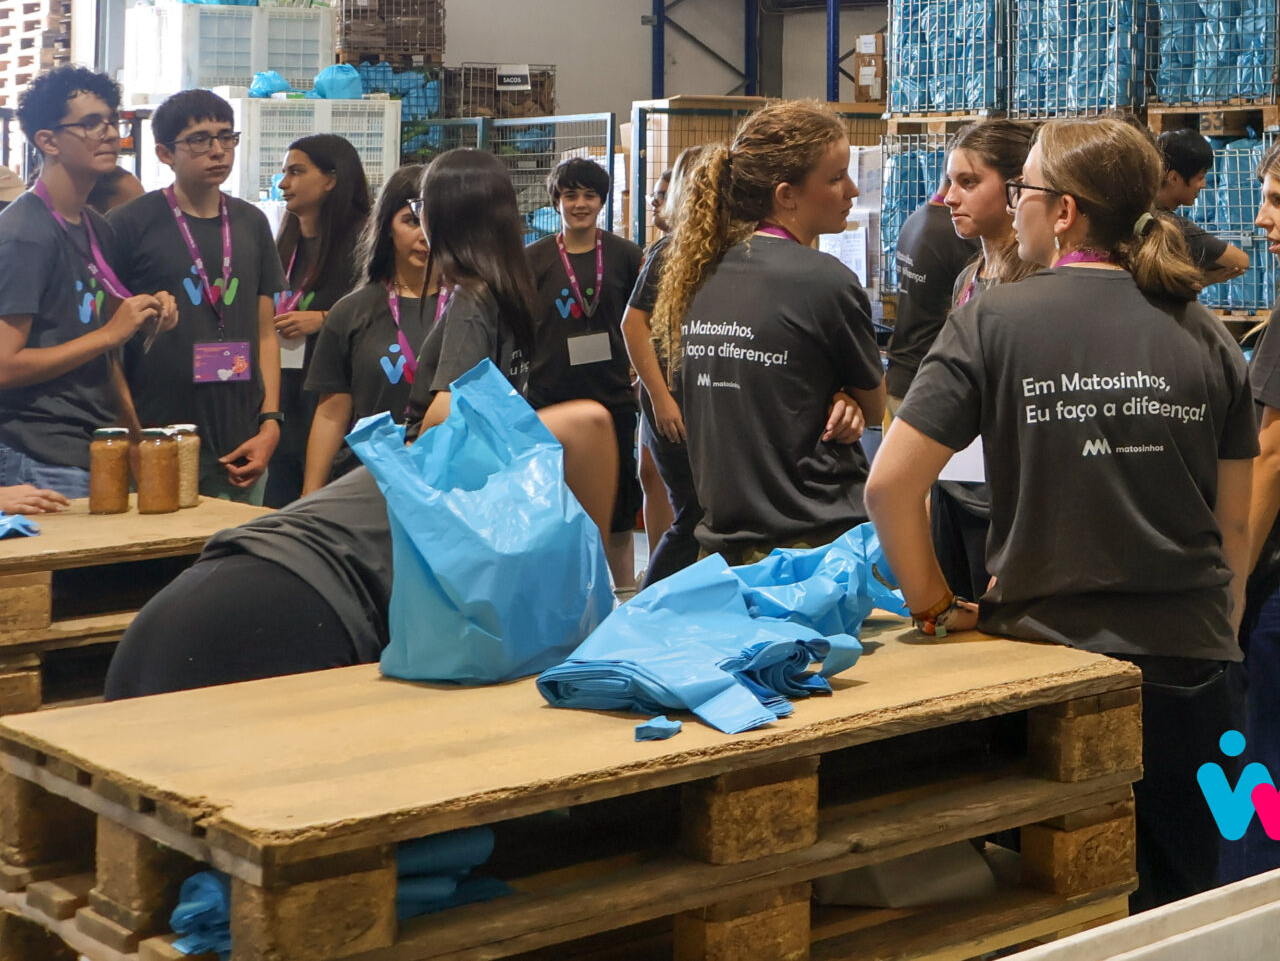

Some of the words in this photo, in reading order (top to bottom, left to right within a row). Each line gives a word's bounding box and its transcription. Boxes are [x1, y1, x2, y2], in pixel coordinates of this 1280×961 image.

[690, 320, 755, 340] Matosinhos,
[707, 345, 715, 356] a
[718, 342, 788, 366] diferença!
[1022, 377, 1055, 397] Em
[1061, 370, 1171, 392] Matosinhos,
[1026, 404, 1050, 424] Eu
[1055, 400, 1097, 423] faço
[1103, 402, 1117, 417] a
[1115, 444, 1164, 454] matosinhos
